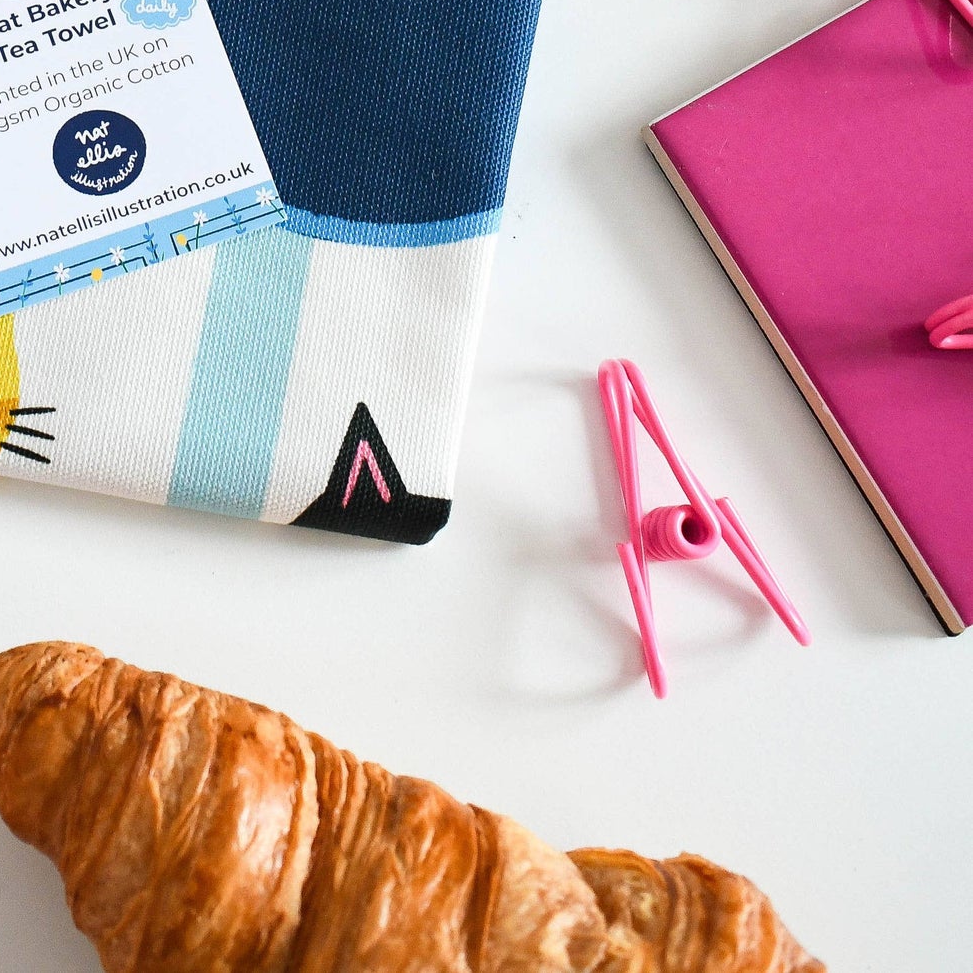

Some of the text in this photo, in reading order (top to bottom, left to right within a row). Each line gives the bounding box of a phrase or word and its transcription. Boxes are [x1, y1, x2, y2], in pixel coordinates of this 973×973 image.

[41, 8, 117, 47] Towel
[44, 77, 124, 109] Organic
[127, 54, 194, 84] Cotton
[45, 72, 66, 87] in
[69, 58, 104, 79] the
[107, 44, 139, 66] UK
[143, 37, 168, 54] on
[75, 120, 110, 145] nat
[70, 150, 138, 192] illustration
[76, 142, 127, 169] ellis
